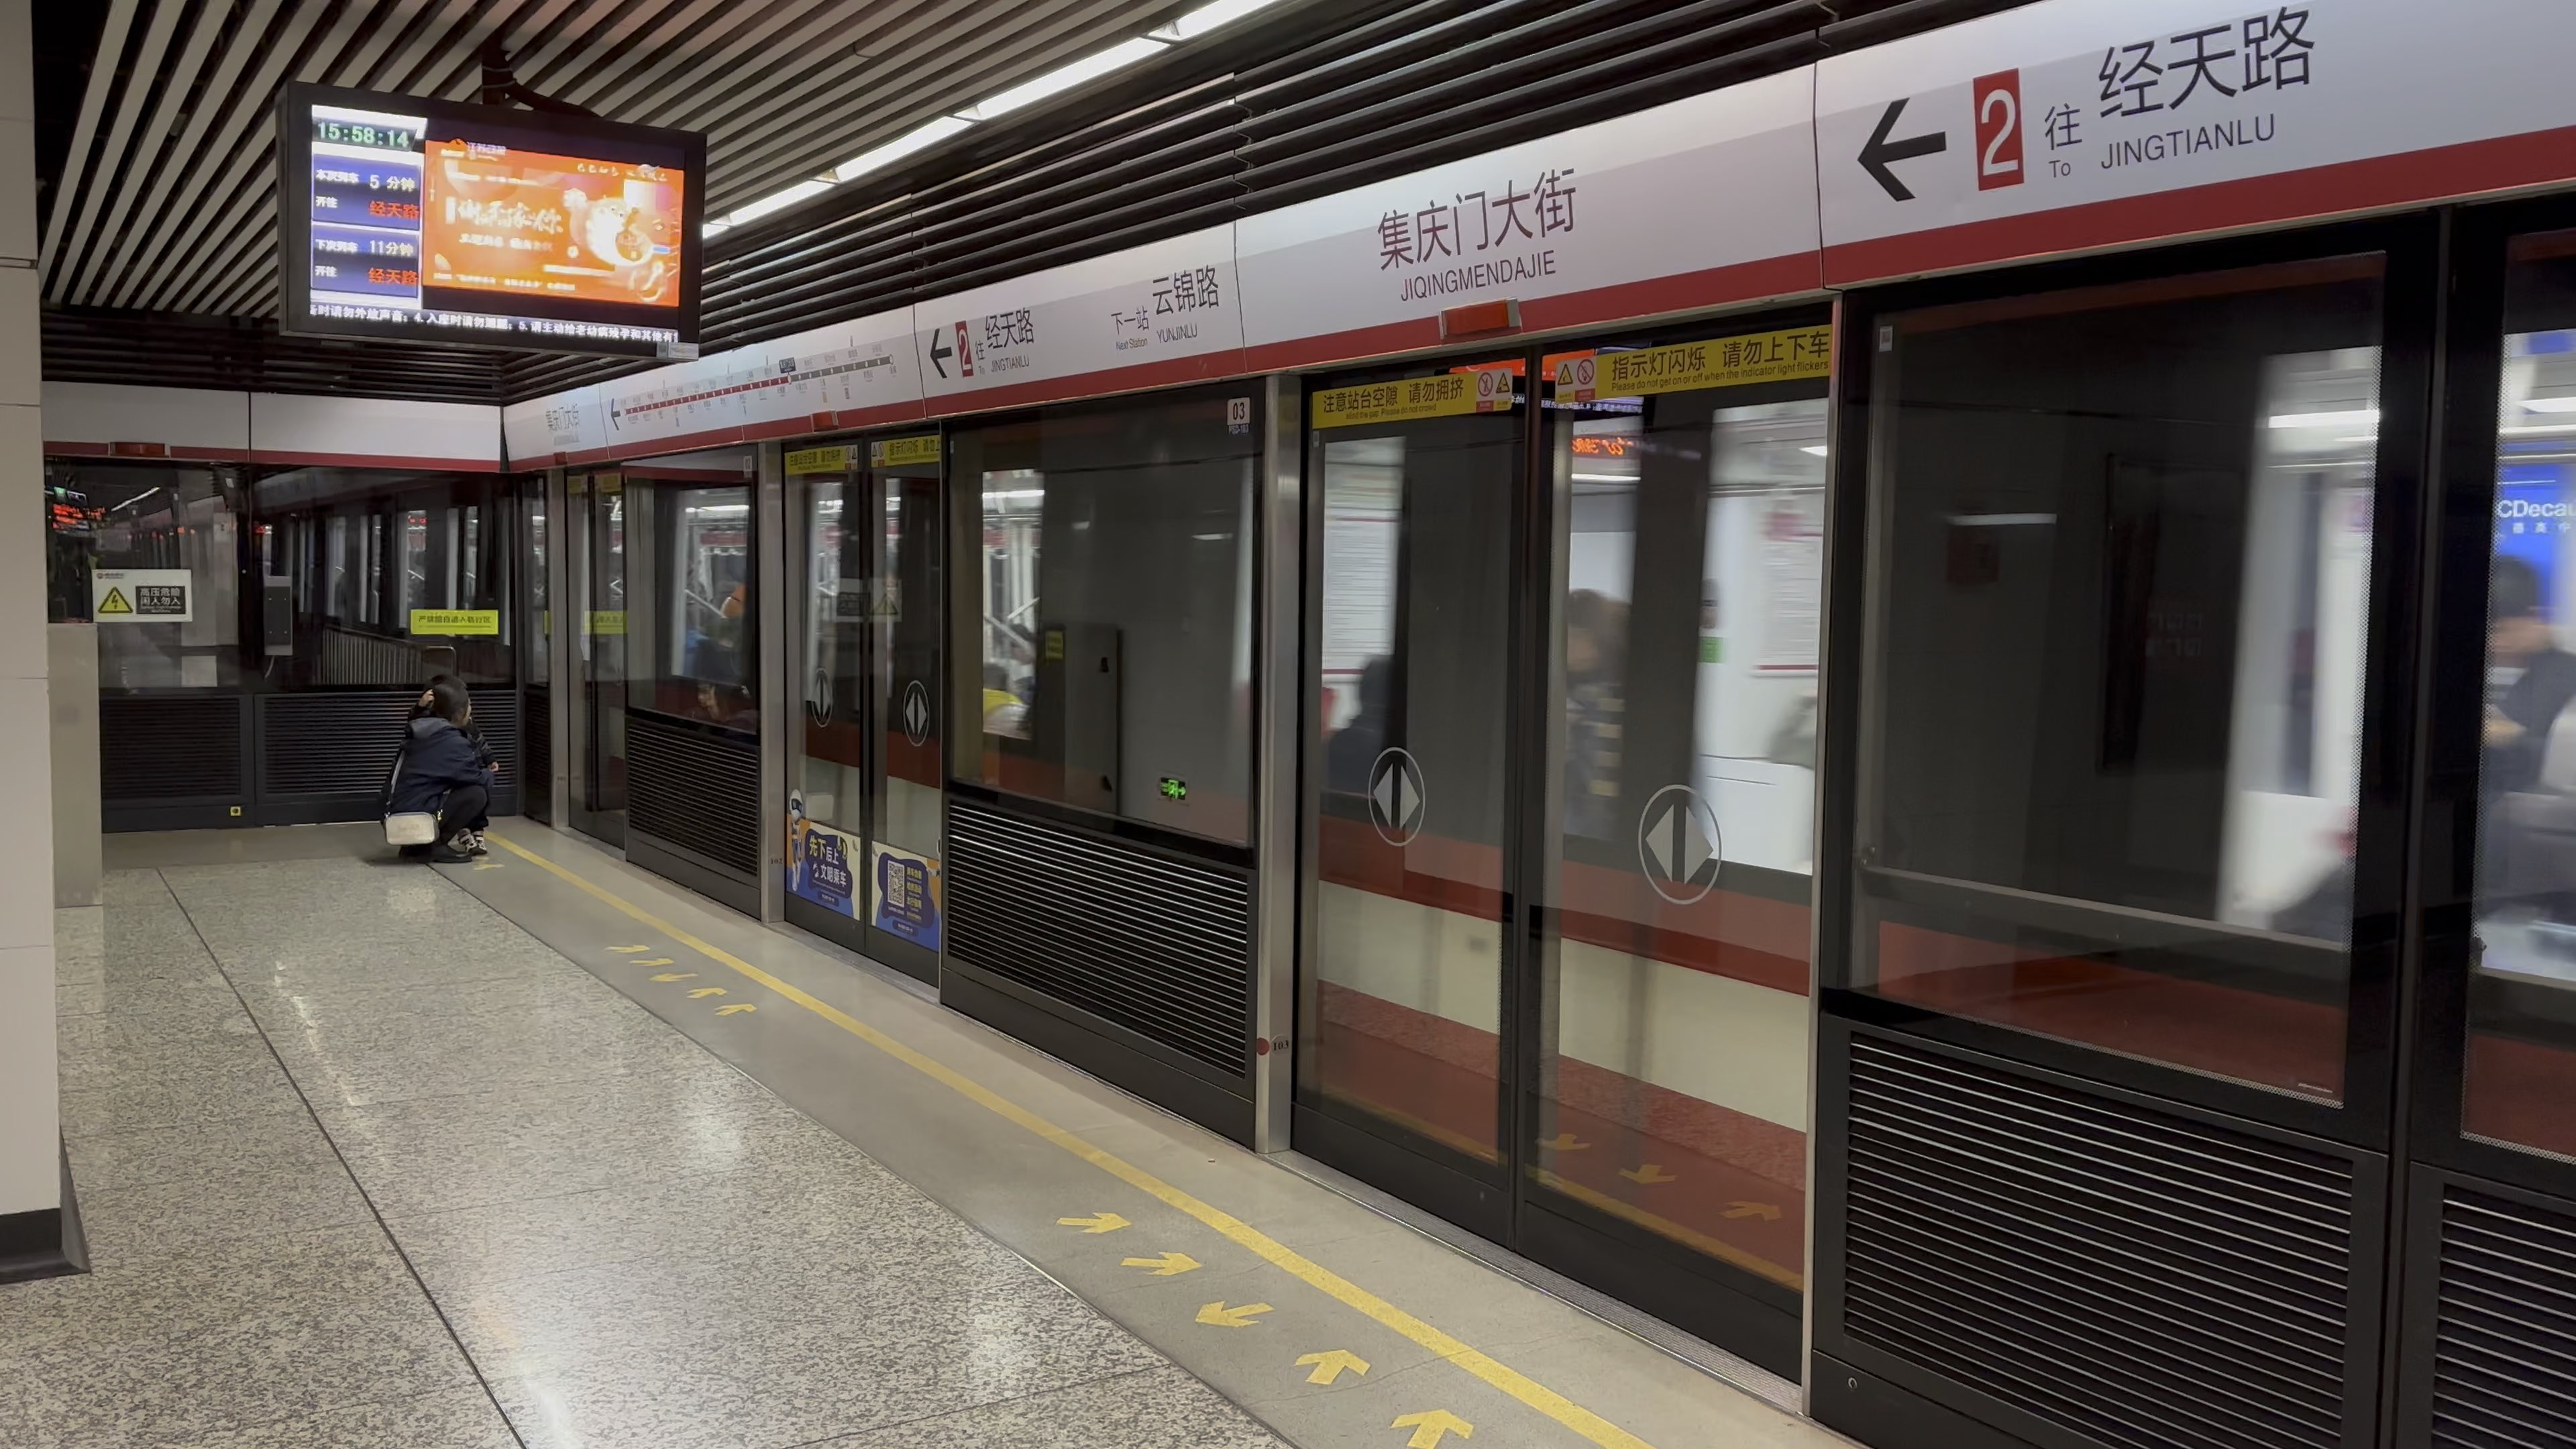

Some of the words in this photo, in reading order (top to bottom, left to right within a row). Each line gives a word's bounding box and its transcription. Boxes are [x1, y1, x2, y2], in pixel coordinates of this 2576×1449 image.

[1981, 89, 2019, 176] 2
[2045, 103, 2082, 150] 往
[2099, 6, 2314, 117] 经天路
[318, 121, 409, 148] 15:58:14
[2049, 160, 2071, 178] To
[2100, 113, 2275, 169] JINGTIANLU
[370, 174, 380, 189] 5
[386, 176, 415, 193] 分钟
[369, 201, 419, 220] 经天路
[1377, 168, 1576, 271] 集庆门大街
[368, 268, 418, 284] 经天路
[1401, 250, 1556, 302] JIQINGMENDAJIE
[1111, 305, 1149, 335] 下一站
[1152, 265, 1219, 315] 云锦路
[959, 328, 972, 371] 2
[975, 339, 985, 361] 往
[985, 307, 1034, 350] 经天路
[1157, 323, 1197, 343] YUNJINLU
[991, 354, 1030, 372] JINGTIANLU
[1612, 345, 1705, 381] 指示灯闪烁
[1723, 331, 1829, 368] 请勿上下车
[1611, 382, 1635, 392] Please
[1637, 380, 1646, 389] do
[1647, 378, 1658, 387] not
[1660, 378, 1671, 388] get
[1672, 376, 1682, 386] on
[1684, 375, 1690, 384] or
[1693, 372, 1703, 383] off
[1705, 370, 1725, 381] when
[1726, 370, 1739, 380] the
[1741, 365, 1776, 378] indicator
[1778, 363, 1796, 376] light
[1797, 360, 1828, 372] flickers
[1324, 385, 1398, 413] 注意站台空隙
[1409, 377, 1464, 404] 请勿拥挤
[1233, 402, 1245, 421] 03
[810, 835, 839, 865] 先下后上
[1273, 1039, 1289, 1051] 103
